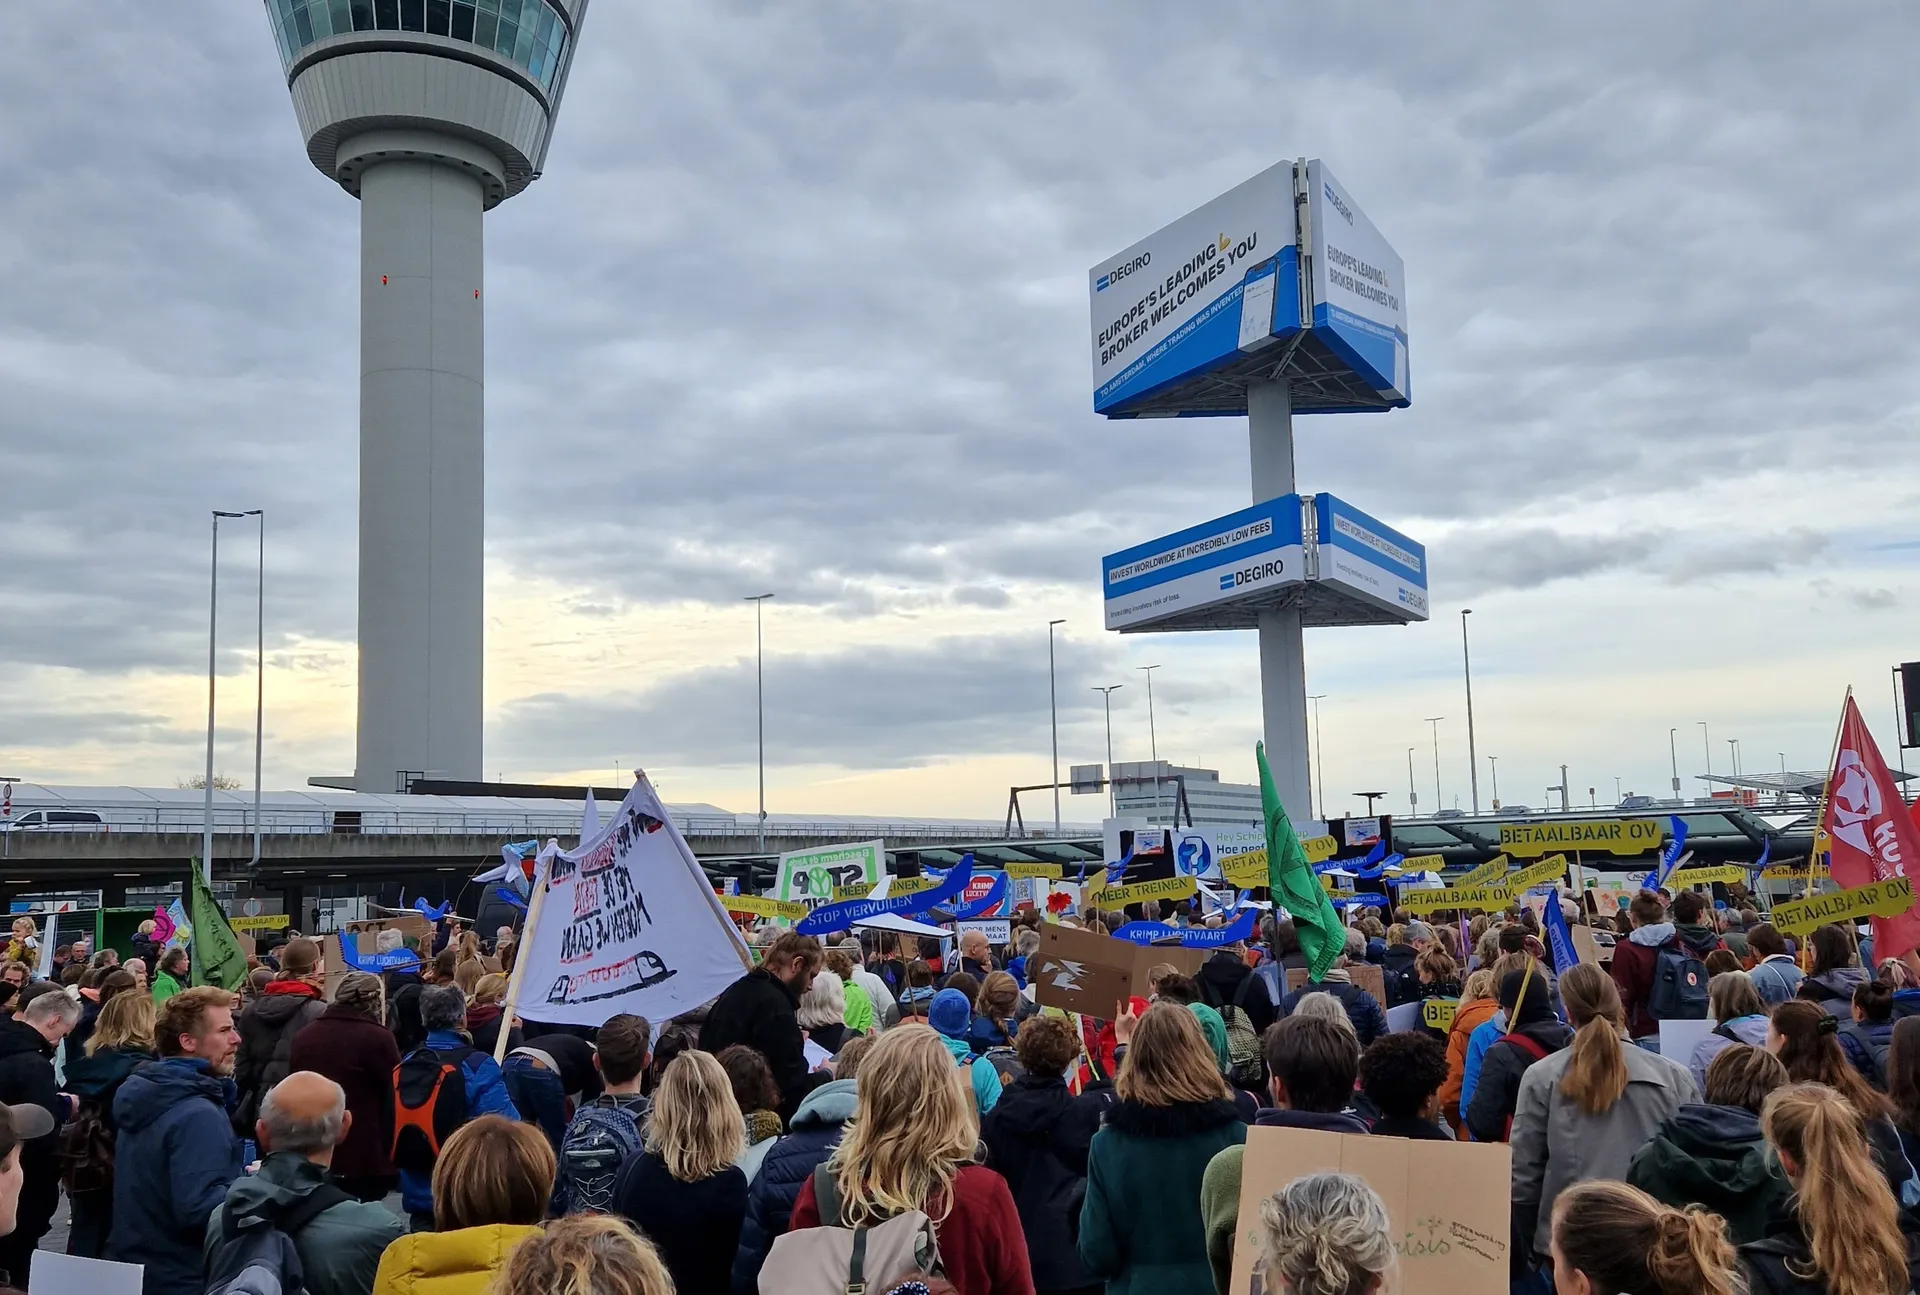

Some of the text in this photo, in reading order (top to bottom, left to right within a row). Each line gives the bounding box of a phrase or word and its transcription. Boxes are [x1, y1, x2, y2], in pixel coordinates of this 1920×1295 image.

[1331, 192, 1354, 226] DEGIRO
[1110, 252, 1151, 284] DEGIRO
[1328, 245, 1383, 285] EUROPE'S LEADING
[1098, 243, 1216, 348] EUROPE'S LEADING
[1330, 267, 1399, 312] BROKER WELCOMES YOU
[1101, 231, 1257, 366] BROKER WELCOMES YOU
[1100, 387, 1109, 398] TO
[1146, 343, 1168, 363] WHERE
[1168, 322, 1196, 346] TRADING
[1195, 310, 1210, 327] WAS
[1210, 285, 1243, 315] INVENTED
[1110, 521, 1271, 581] INVEST WORLDWIDE AT INCREDIBLY LOW FEES
[1235, 559, 1284, 586] DEGIRO
[1152, 597, 1162, 607] risk
[1162, 596, 1169, 604] of
[1405, 590, 1427, 611] DEGIRO
[1216, 832, 1234, 841] Hey
[1500, 823, 1657, 844] BETAALBAAR OV
[1216, 844, 1239, 854] Hoe
[1316, 837, 1335, 850] OV
[1326, 856, 1368, 869] LUCHTVAART
[1399, 858, 1430, 869] ALBAAR
[1432, 855, 1443, 864] OV
[1496, 858, 1507, 870] OV
[1510, 871, 1530, 886] MEER
[1531, 858, 1561, 879] TREINEN
[1730, 866, 1743, 875] OV
[839, 884, 869, 897] MEER
[972, 882, 994, 890] KRIMP
[1097, 878, 1188, 903] MEER TREINEN
[1401, 888, 1512, 905] BETAALBAAR OV
[1773, 879, 1911, 929] BETAALBAAR OV
[776, 902, 801, 914] EINEN
[808, 910, 840, 927] STOP
[844, 894, 913, 919] VERVUILEN
[917, 910, 932, 921] STO
[230, 918, 274, 927] TAALBAAR
[1130, 929, 1160, 940] KRIMP
[357, 955, 376, 966] KRIMP
[1426, 1005, 1457, 1021] BET
